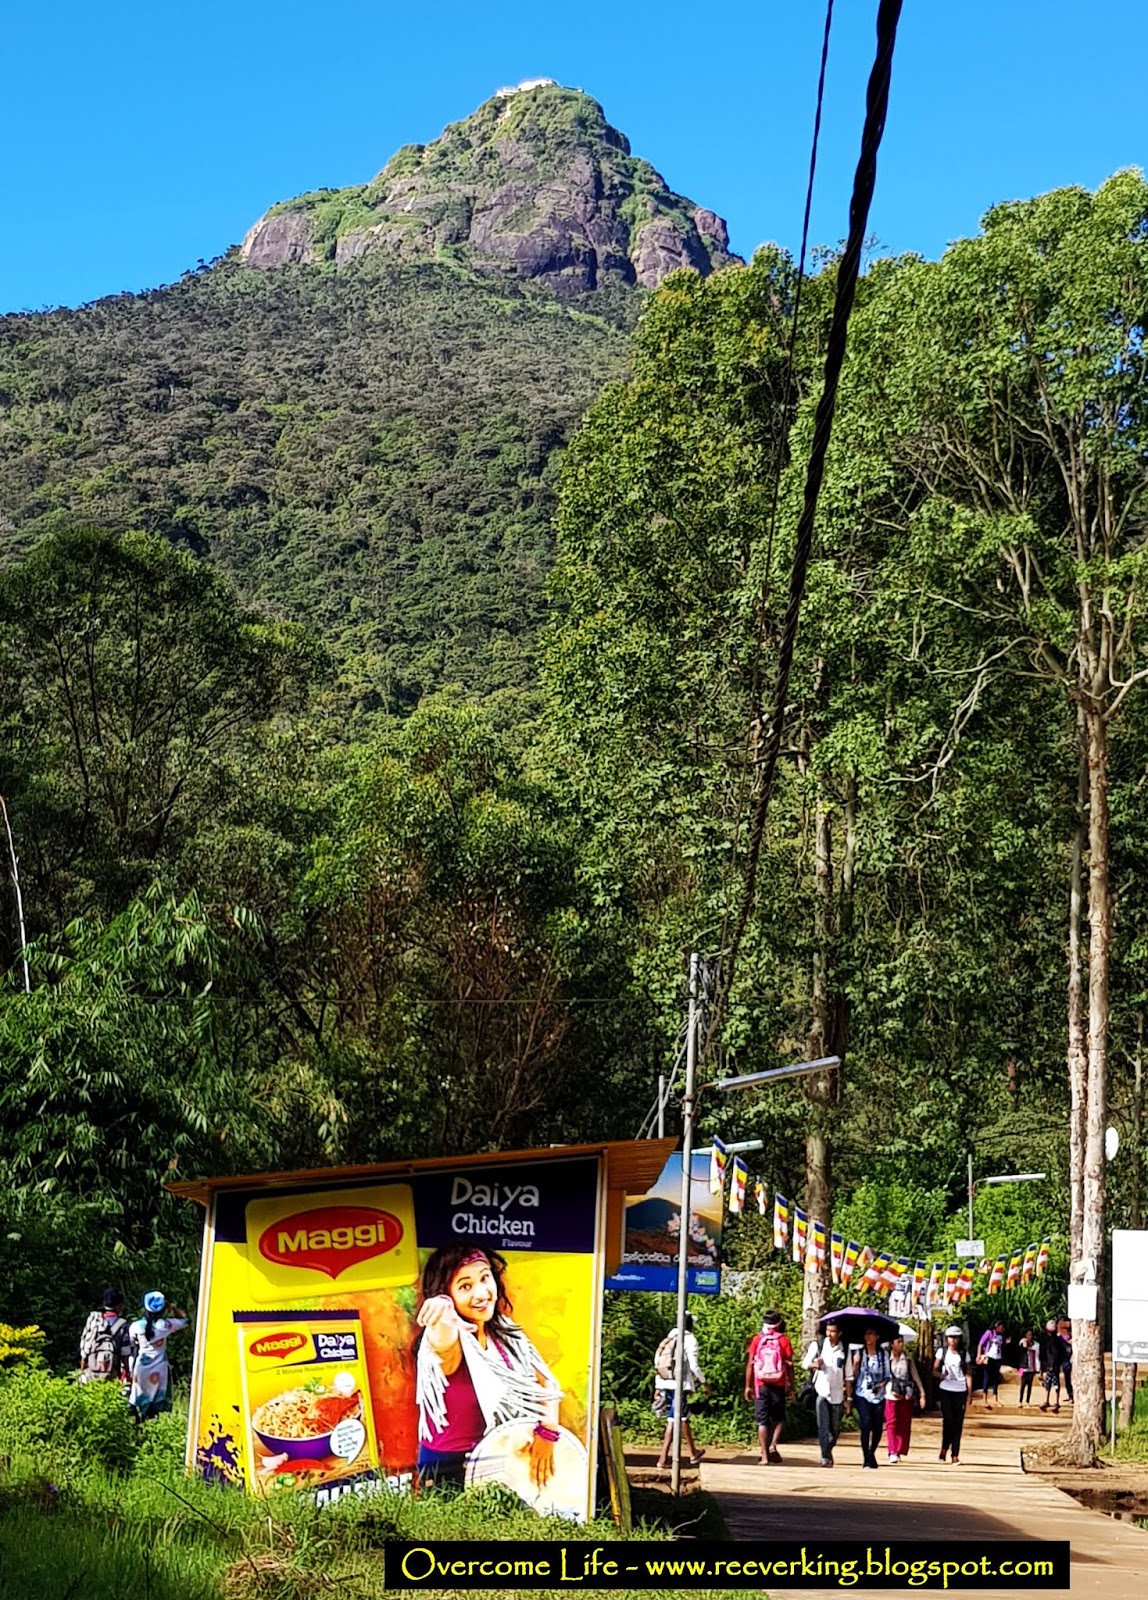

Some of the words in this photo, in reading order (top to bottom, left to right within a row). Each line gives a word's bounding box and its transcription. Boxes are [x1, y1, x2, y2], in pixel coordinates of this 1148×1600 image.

[451, 1177, 540, 1212] Daiya
[451, 1213, 536, 1236] Chicken
[277, 1220, 386, 1254] Maggi
[255, 1335, 303, 1353] Maggi
[318, 1334, 355, 1348] Daiya
